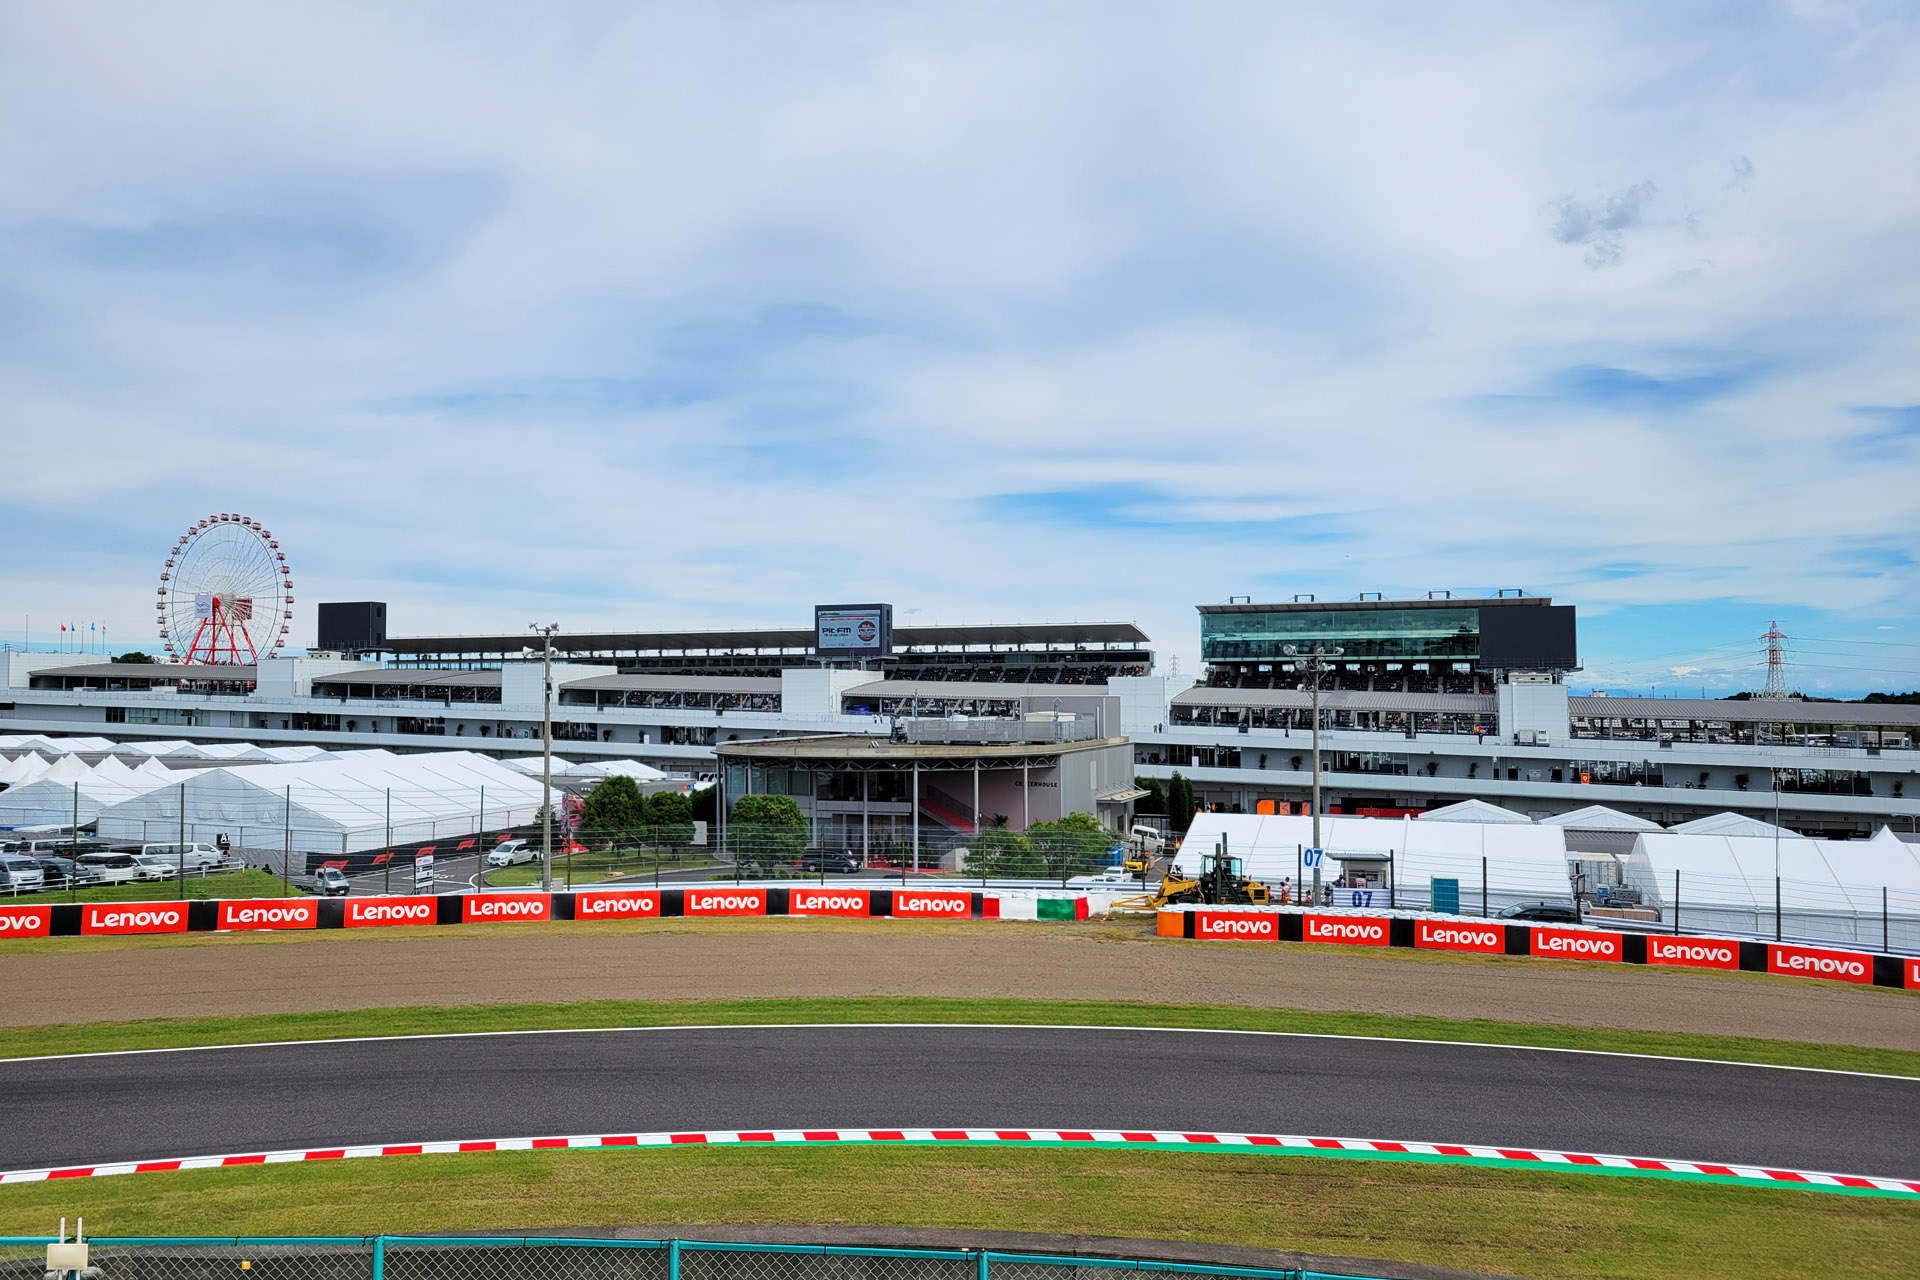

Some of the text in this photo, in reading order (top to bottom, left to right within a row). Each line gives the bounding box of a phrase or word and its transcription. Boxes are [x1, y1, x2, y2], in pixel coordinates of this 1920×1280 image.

[1304, 849, 1323, 867] 07
[471, 899, 544, 916] Lenovo
[583, 897, 654, 914] Lenovo
[691, 894, 760, 910] Lenovo
[796, 893, 864, 910] Lenovo
[899, 895, 965, 913] Lenovo
[1352, 890, 1373, 908] 07
[92, 910, 180, 927] Lenovo
[227, 906, 309, 923] Lenovo
[353, 903, 430, 920] Lenovo
[1202, 916, 1272, 934] Lenovo
[1309, 919, 1383, 939] Lenovo
[1422, 926, 1497, 946] Lenovo
[1538, 932, 1615, 955] Lenovo
[1653, 940, 1732, 962] Lenovo
[1776, 950, 1865, 976] Lenovo
